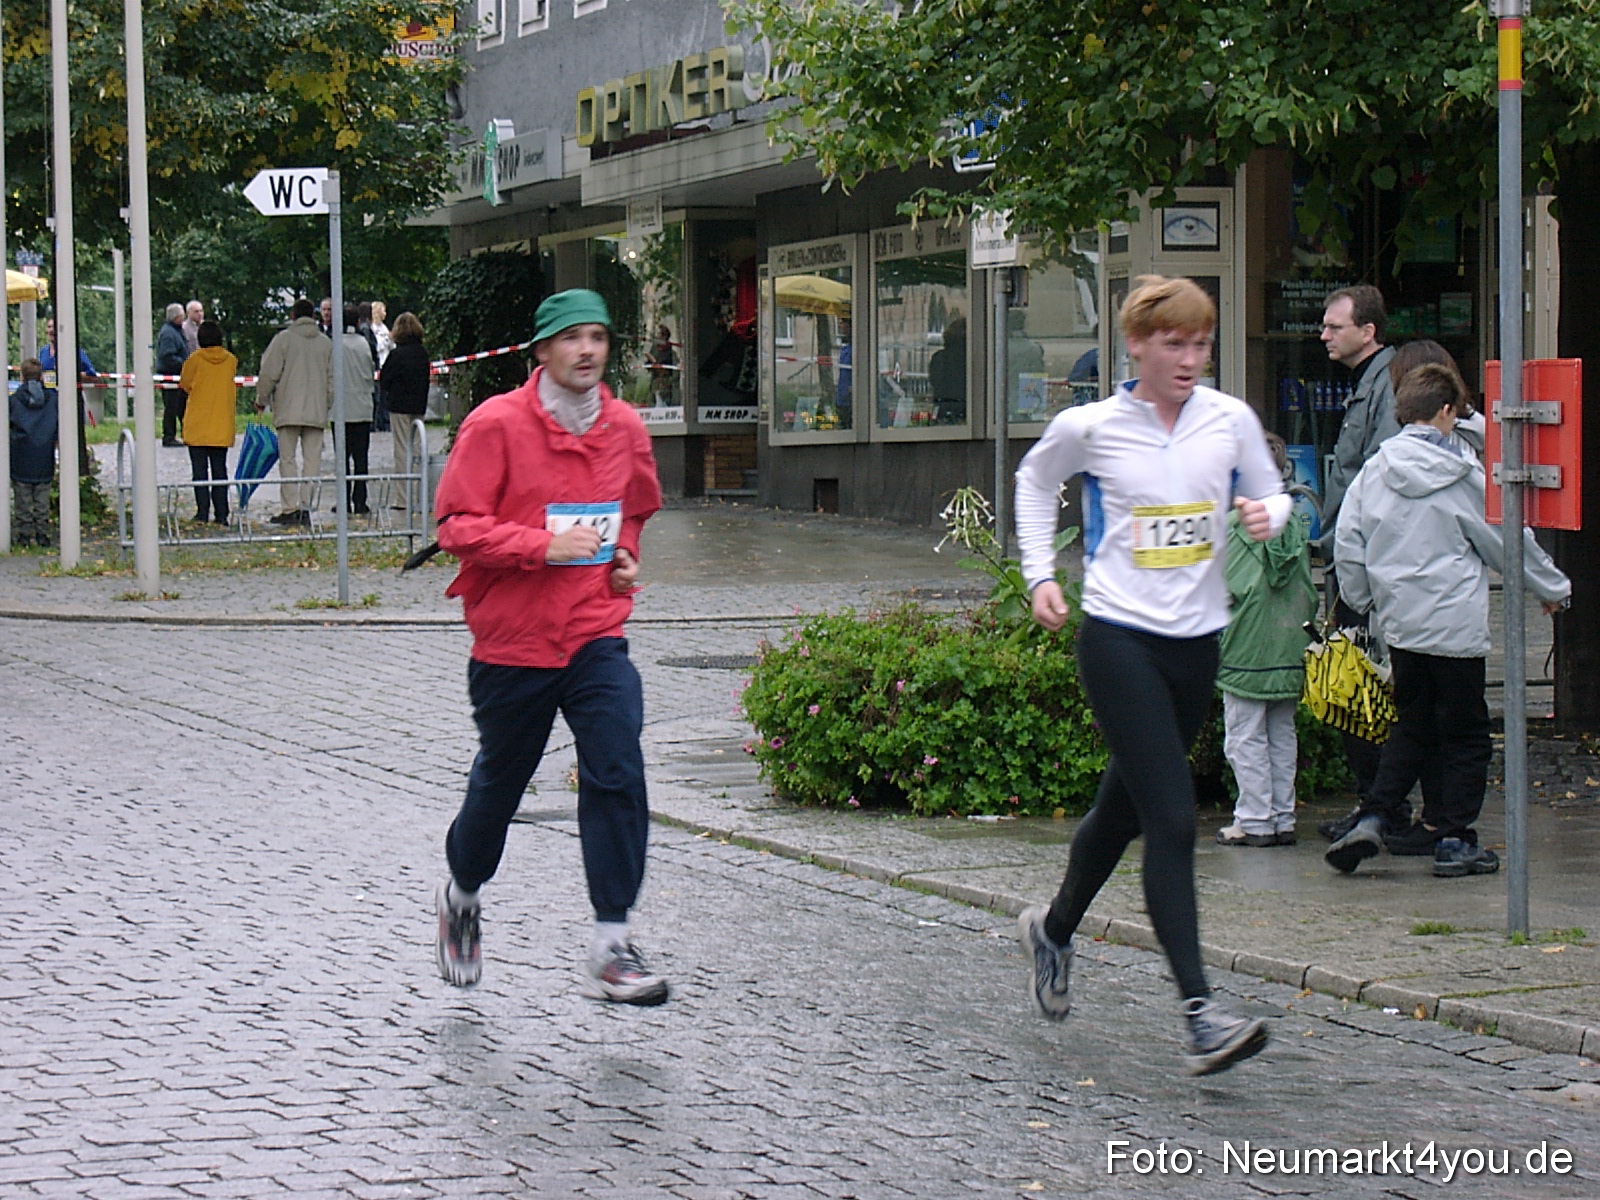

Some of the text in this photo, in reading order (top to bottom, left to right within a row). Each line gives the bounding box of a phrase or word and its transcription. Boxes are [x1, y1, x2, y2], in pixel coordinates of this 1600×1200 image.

[577, 46, 736, 147] OPTIKER
[497, 143, 520, 183] SHOP
[269, 175, 317, 208] WC
[705, 409, 722, 420] MM
[723, 409, 749, 420] SHOP
